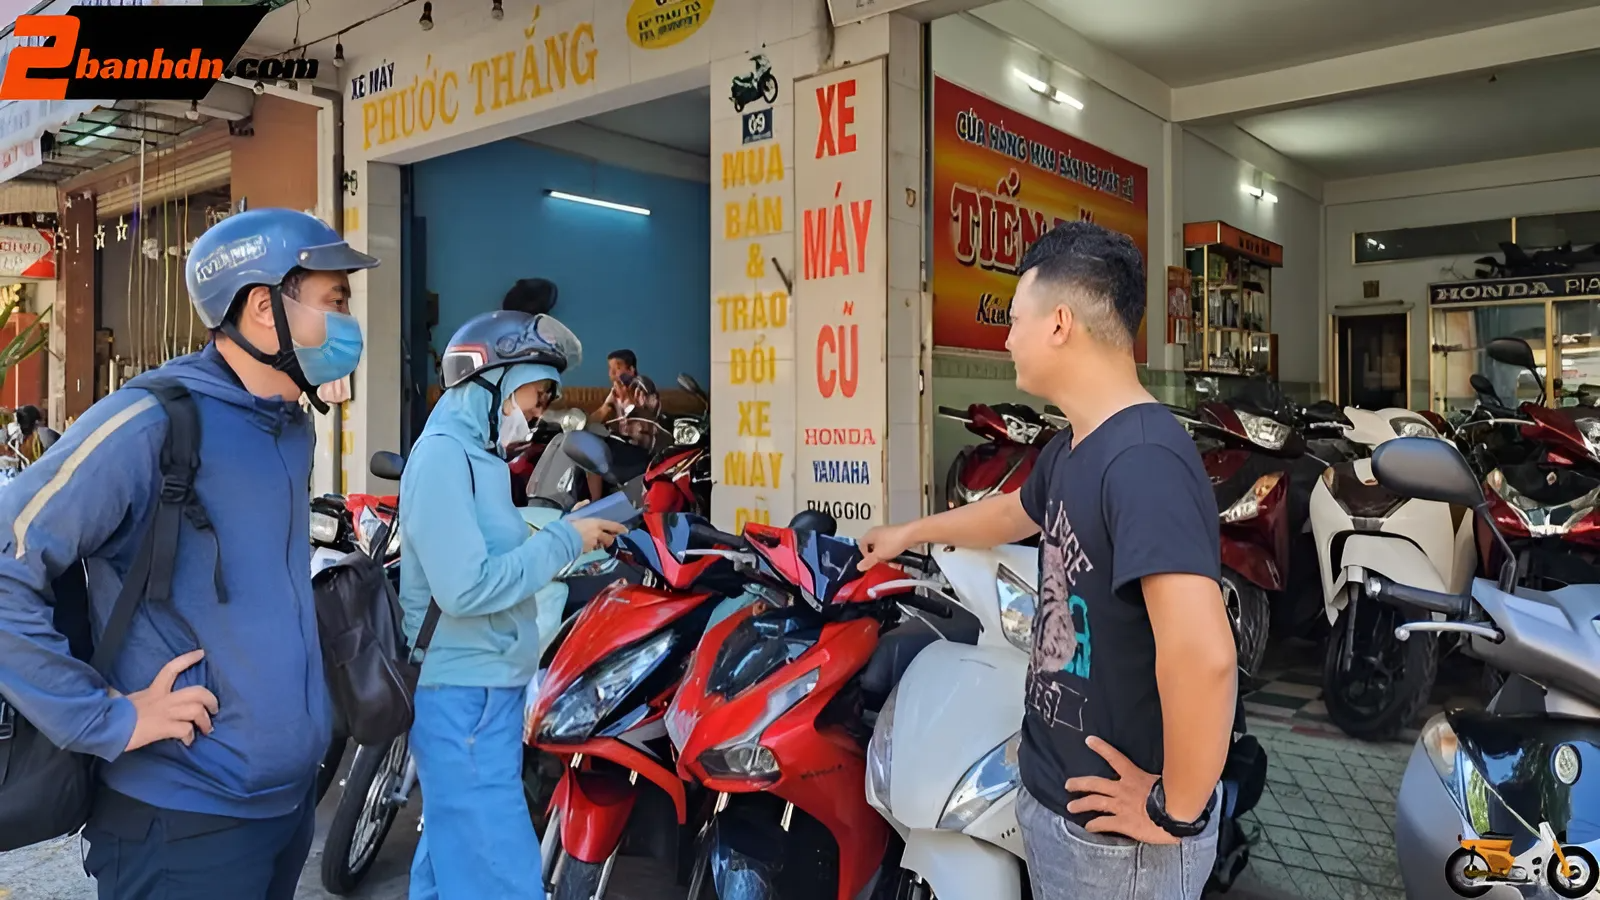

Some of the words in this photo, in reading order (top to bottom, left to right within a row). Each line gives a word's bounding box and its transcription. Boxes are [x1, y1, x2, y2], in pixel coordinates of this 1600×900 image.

[362, 54, 459, 151] PHƯỚC
[467, 4, 598, 117] THẮNG
[815, 79, 857, 159] XE
[722, 142, 785, 191] MUA
[724, 192, 782, 240] BÁN
[804, 181, 872, 280] MÁY
[746, 243, 765, 278] &
[717, 291, 788, 332] TRAO
[1435, 281, 1554, 301] HONDA
[816, 301, 859, 398] CŨ
[737, 401, 771, 438] XE
[805, 428, 876, 445] HONDA
[812, 460, 870, 485] YAMAHA
